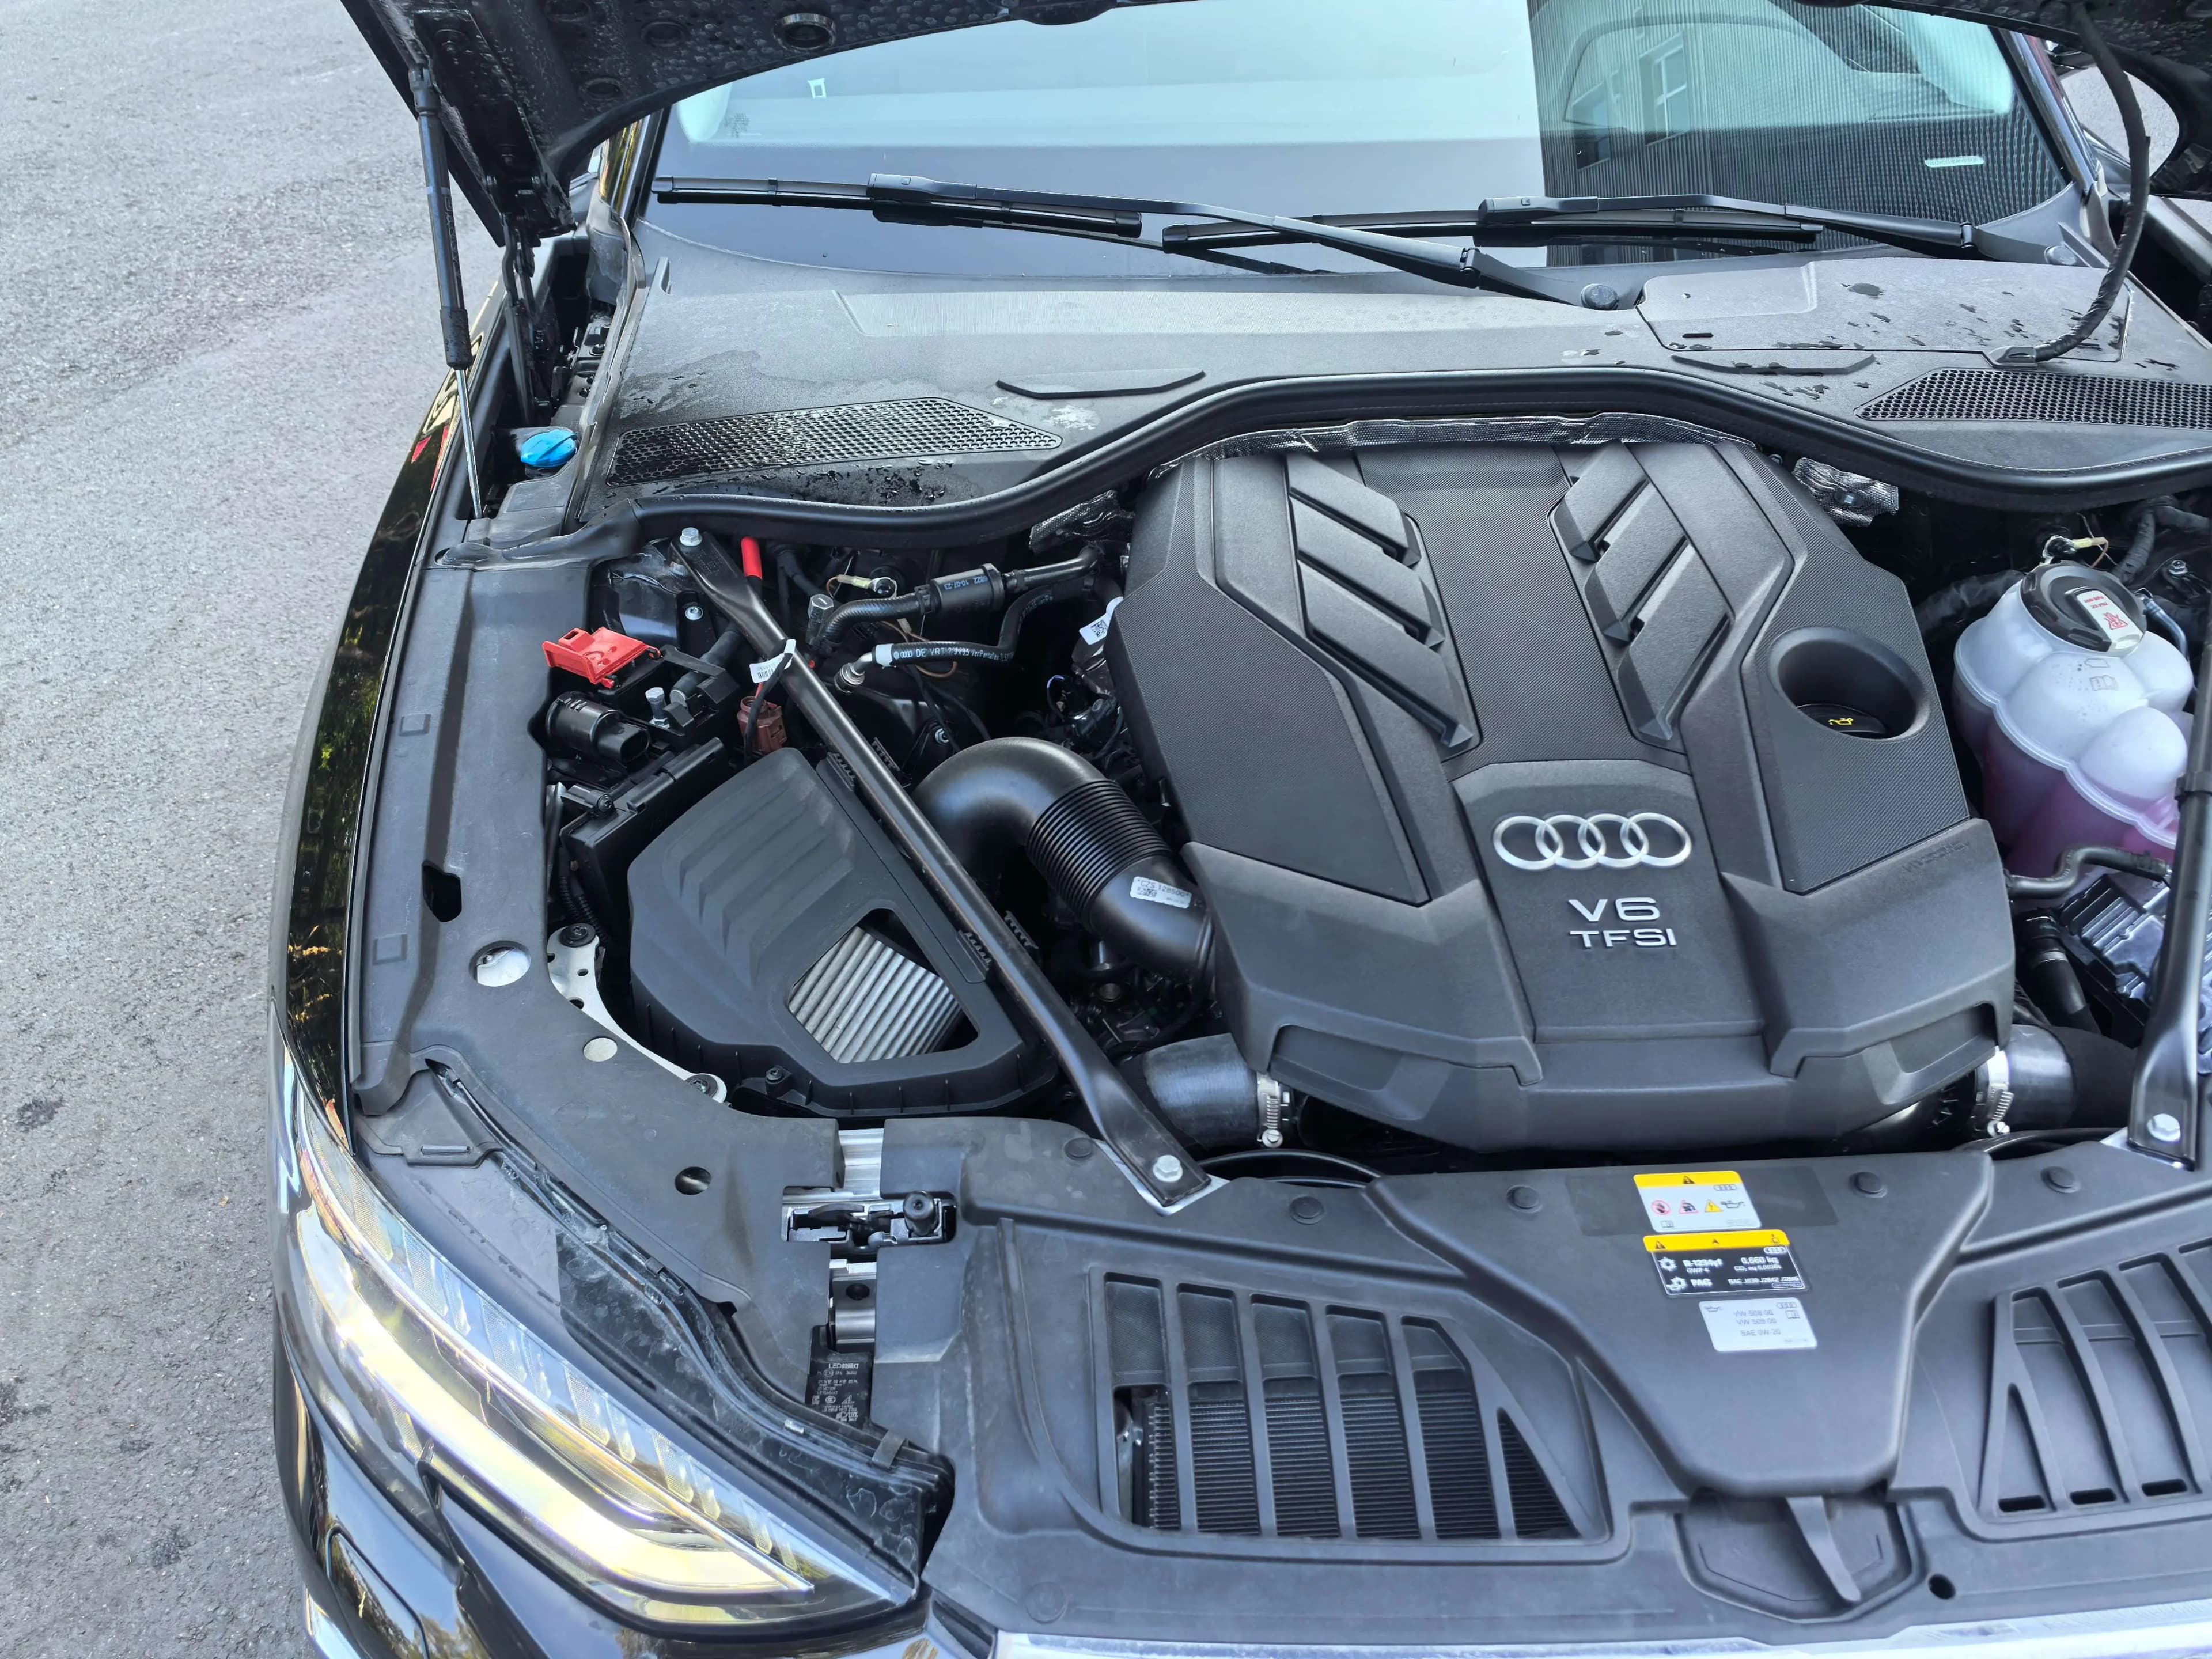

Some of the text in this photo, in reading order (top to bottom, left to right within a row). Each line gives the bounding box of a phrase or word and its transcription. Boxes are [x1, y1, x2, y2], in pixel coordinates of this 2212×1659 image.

[916, 648, 926, 657] DE
[1568, 896, 1660, 922] V6
[1570, 928, 1677, 949] TFSI
[1690, 1278, 1713, 1287] PAG
